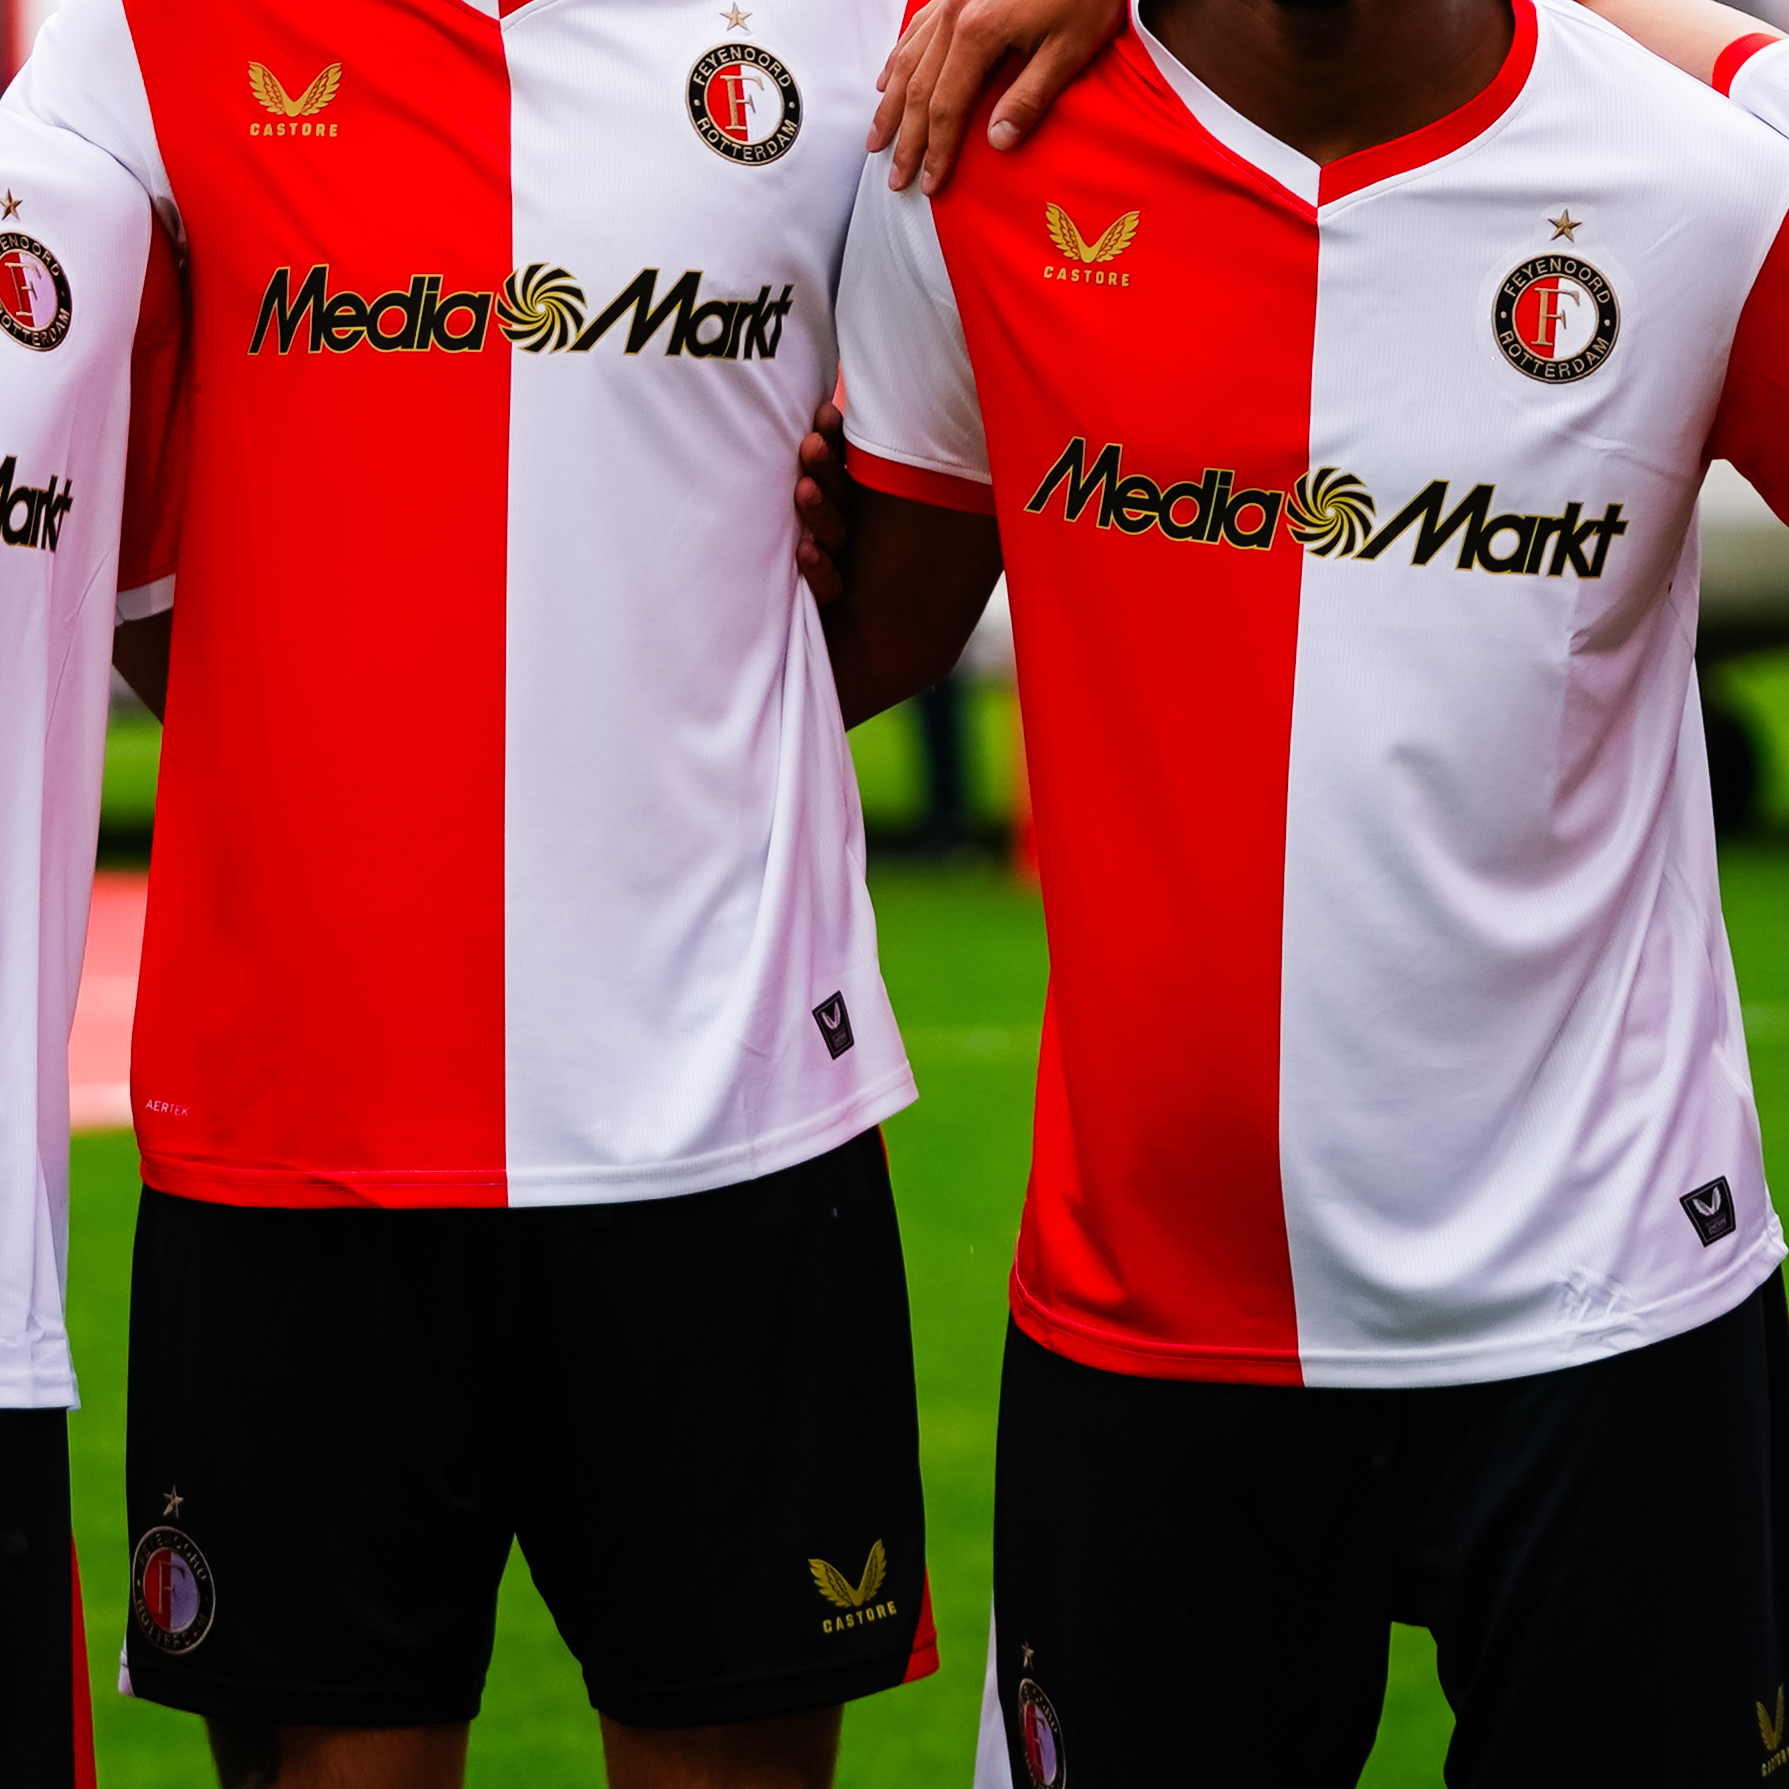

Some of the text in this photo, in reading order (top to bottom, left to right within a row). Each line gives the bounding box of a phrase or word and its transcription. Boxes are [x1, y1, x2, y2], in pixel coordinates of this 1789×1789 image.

[693, 46, 792, 87] FEYENOORD
[249, 122, 339, 138] CASTORE
[696, 117, 798, 161] ROTTERDAM
[1043, 265, 1131, 288] CASTORE
[1504, 257, 1611, 304] FEYENOORD
[247, 263, 794, 361] Media Markt
[1499, 329, 1610, 378] ROTTERDAM
[1023, 435, 1630, 579] Media Markt
[822, 1600, 898, 1634] CASTORE
